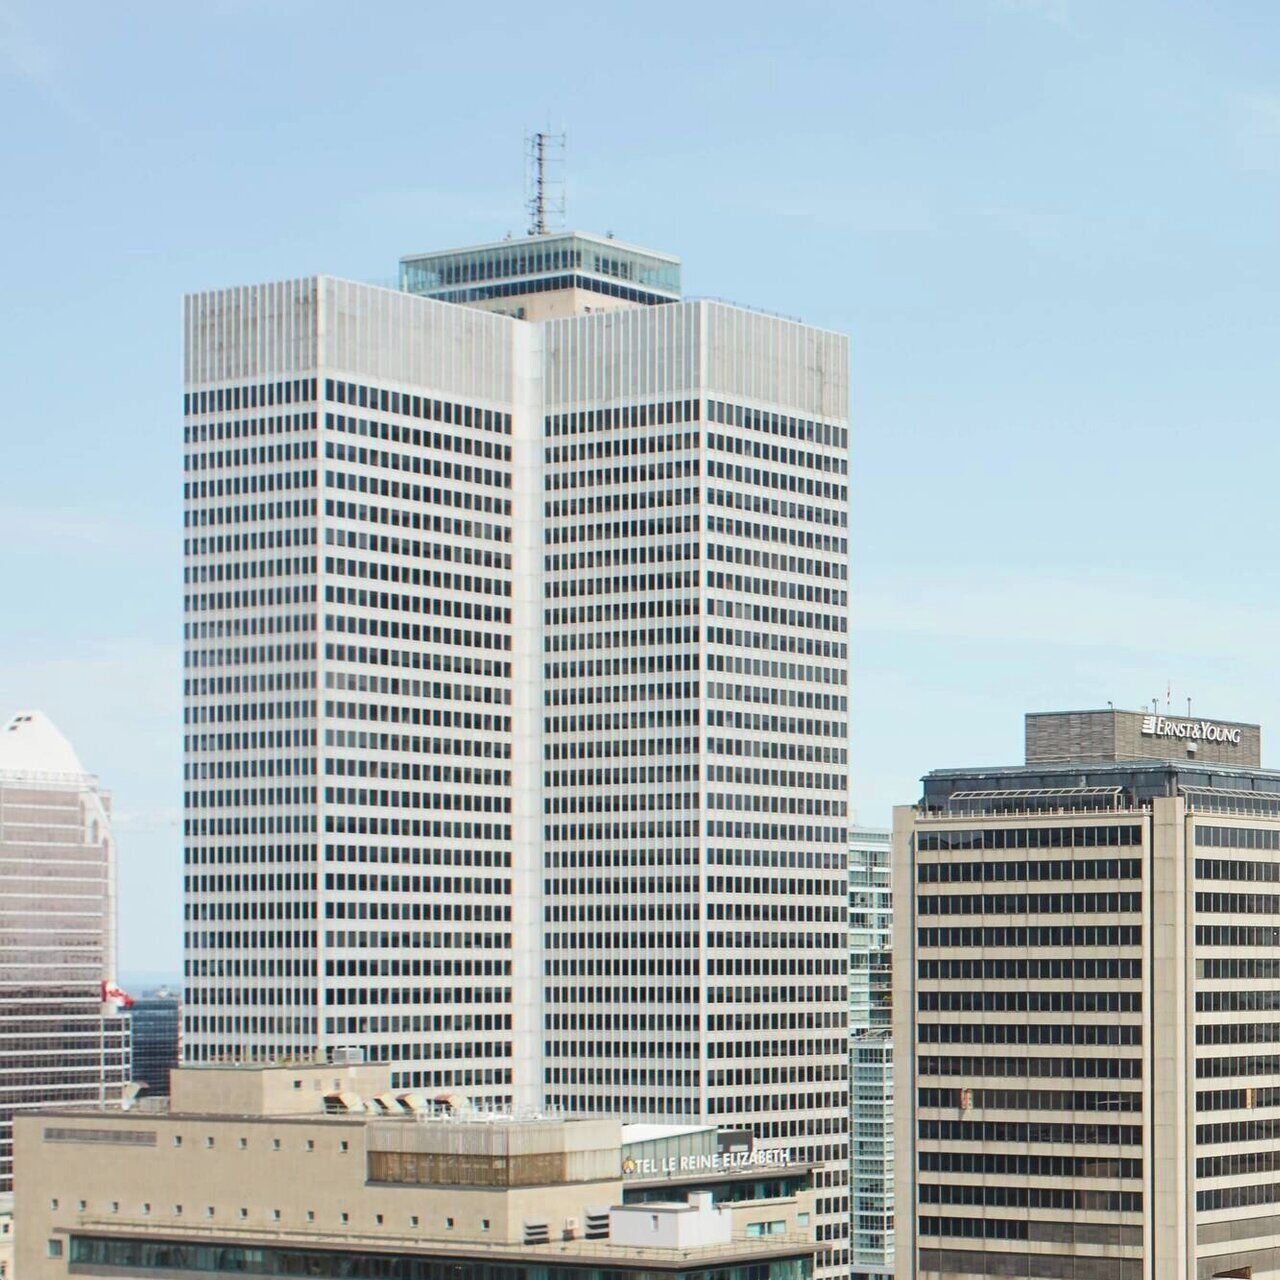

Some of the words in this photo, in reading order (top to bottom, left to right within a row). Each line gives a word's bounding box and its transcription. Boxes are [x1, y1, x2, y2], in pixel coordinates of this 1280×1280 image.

[661, 1158, 676, 1172] LE
[680, 1154, 719, 1170] REINE
[723, 1148, 790, 1166] ELIZABETH
